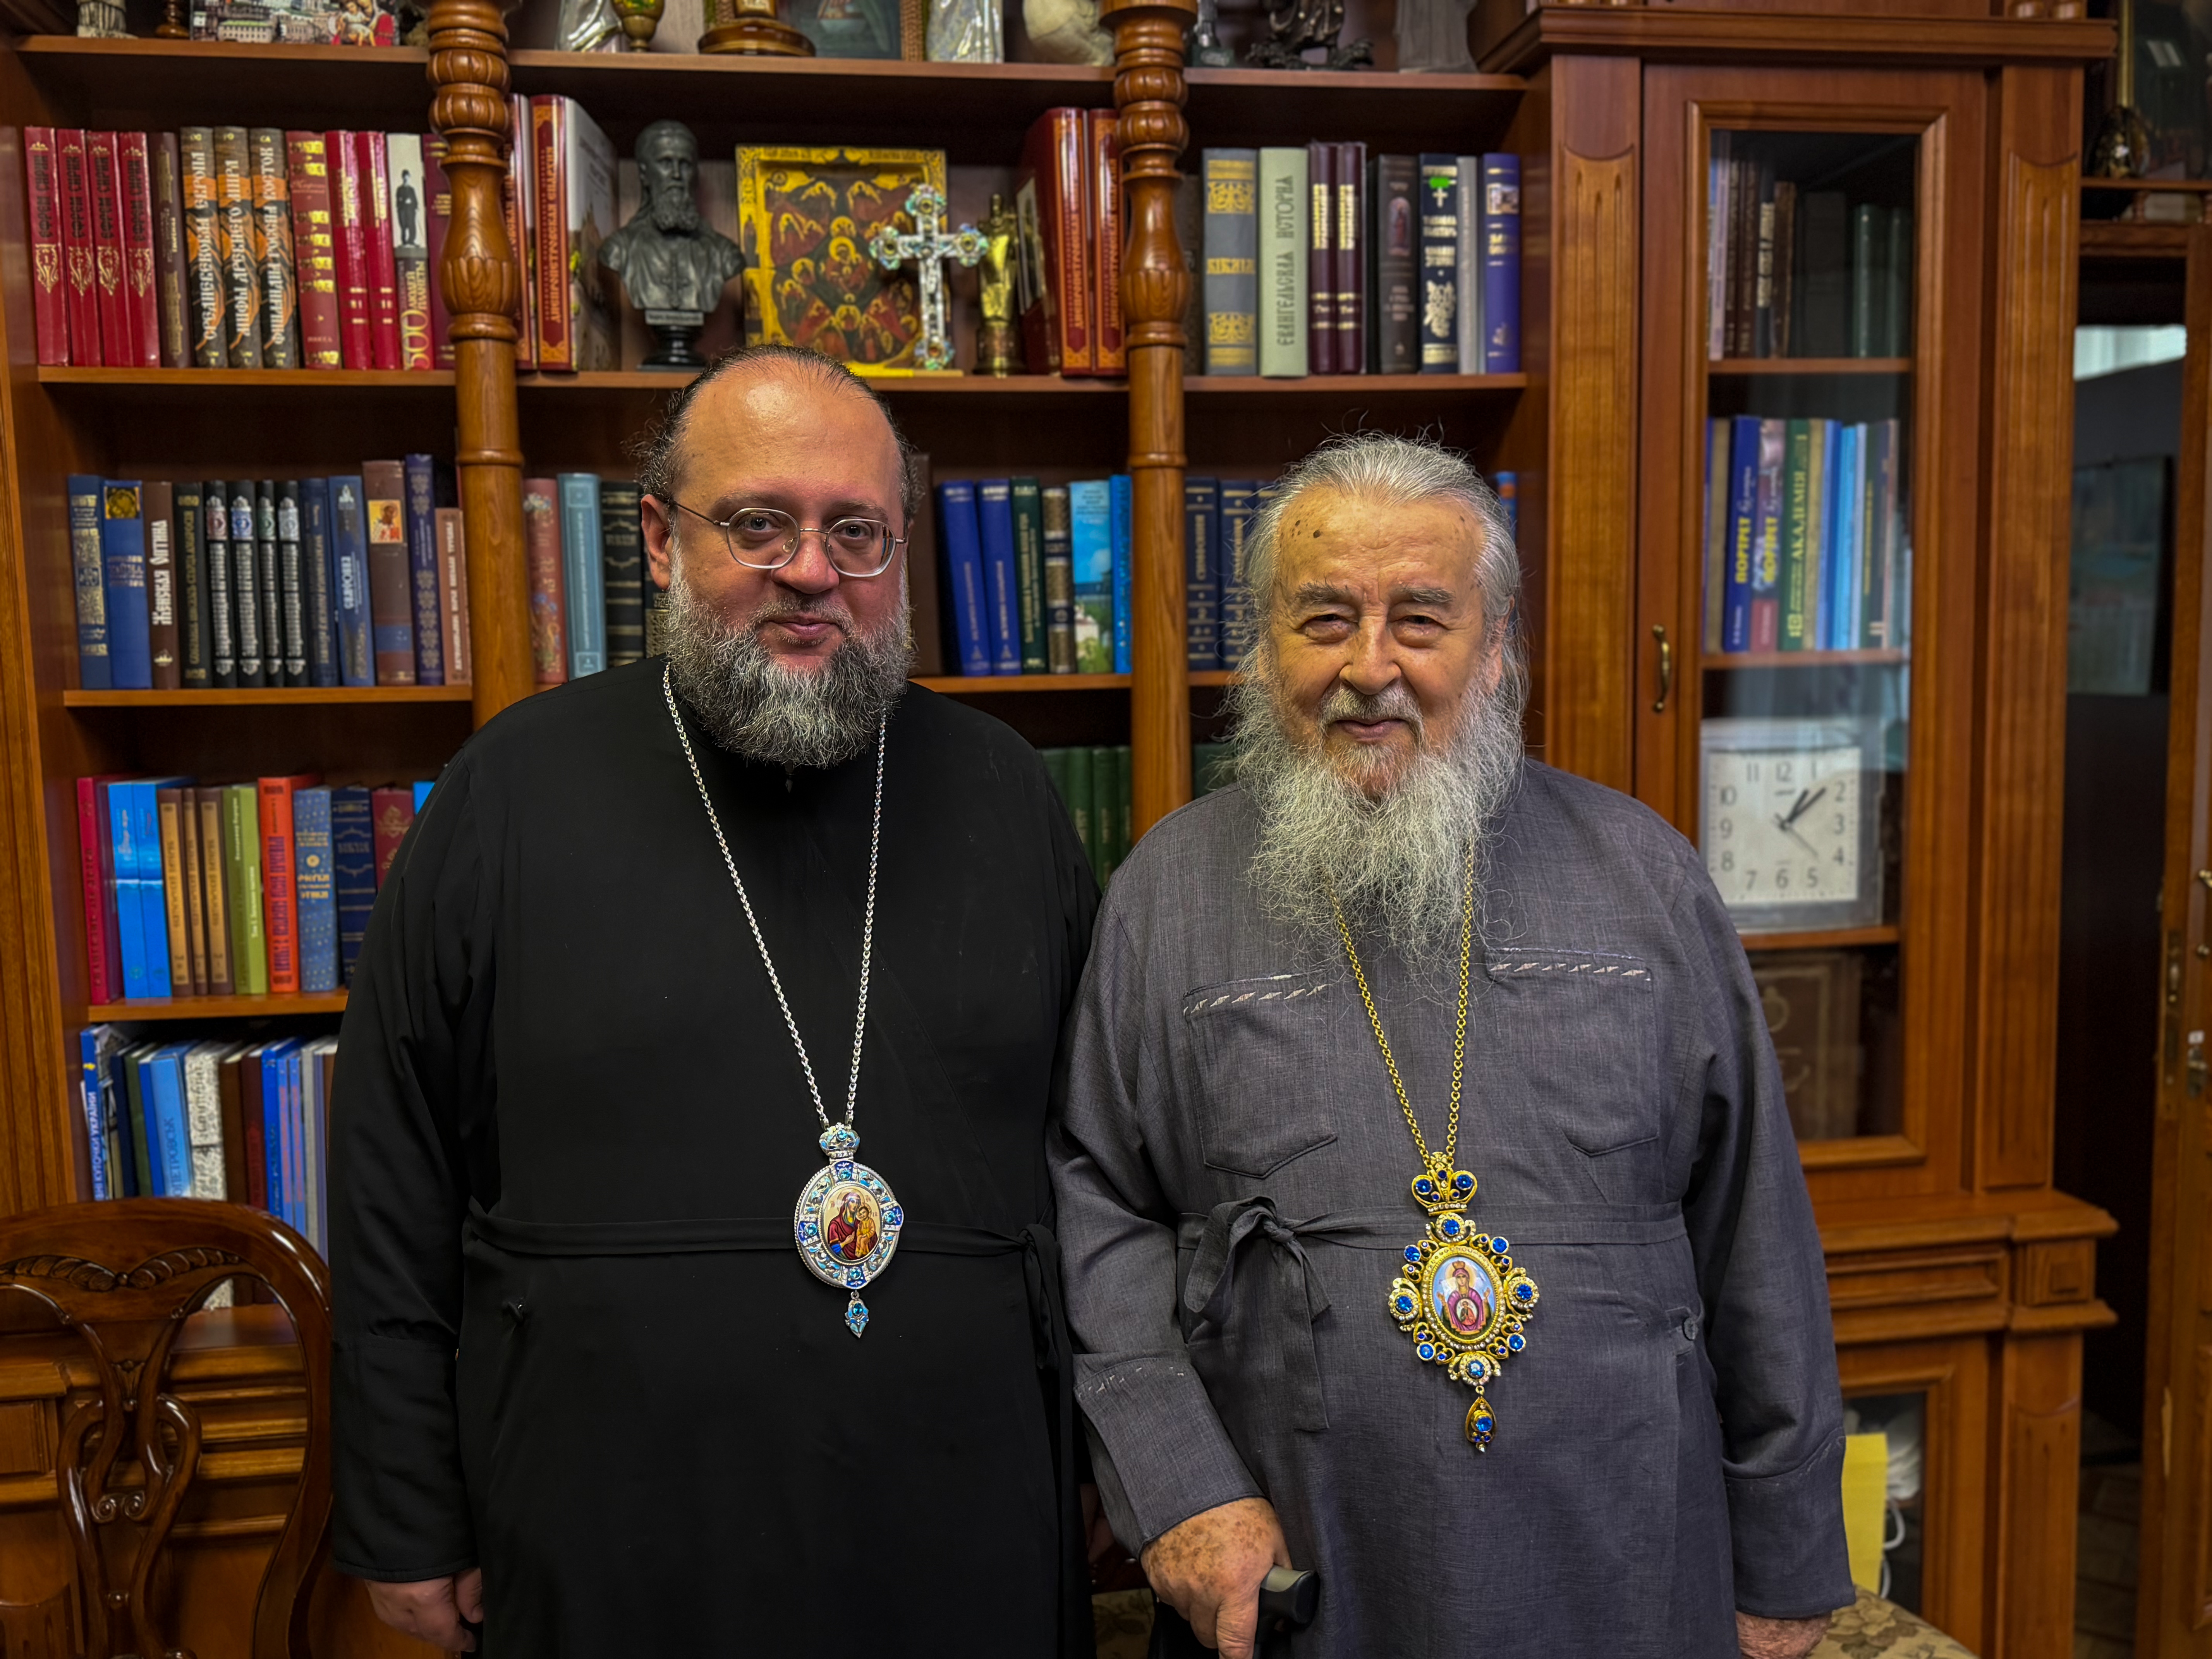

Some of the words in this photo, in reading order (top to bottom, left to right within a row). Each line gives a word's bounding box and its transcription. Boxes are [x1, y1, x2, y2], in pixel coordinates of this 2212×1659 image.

[225, 160, 241, 202] МИРА
[260, 147, 275, 201] ВОСТОК
[1276, 175, 1293, 239] ИСТОРИЯ
[228, 208, 248, 283] ДРЕВНЕГО
[405, 271, 416, 309] ЛЮДЕЙ
[415, 261, 427, 309] ПЛАНЕТЫ
[233, 287, 251, 336] МИФЫ
[402, 309, 430, 369] 500
[1747, 763, 1759, 782] 11
[1776, 763, 1792, 781] 12
[1720, 787, 1737, 805] 10
[1836, 782, 1846, 802] 2
[1720, 819, 1733, 839] 9
[1835, 815, 1845, 834] 3
[1721, 852, 1734, 871] 8
[1834, 847, 1844, 865] 4
[1746, 871, 1757, 890] 7
[1776, 869, 1789, 888] 6
[1807, 868, 1818, 887] 5
[87, 1091, 99, 1137] УКРАЇНИ
[91, 1137, 103, 1182] КУТОЧКИ
